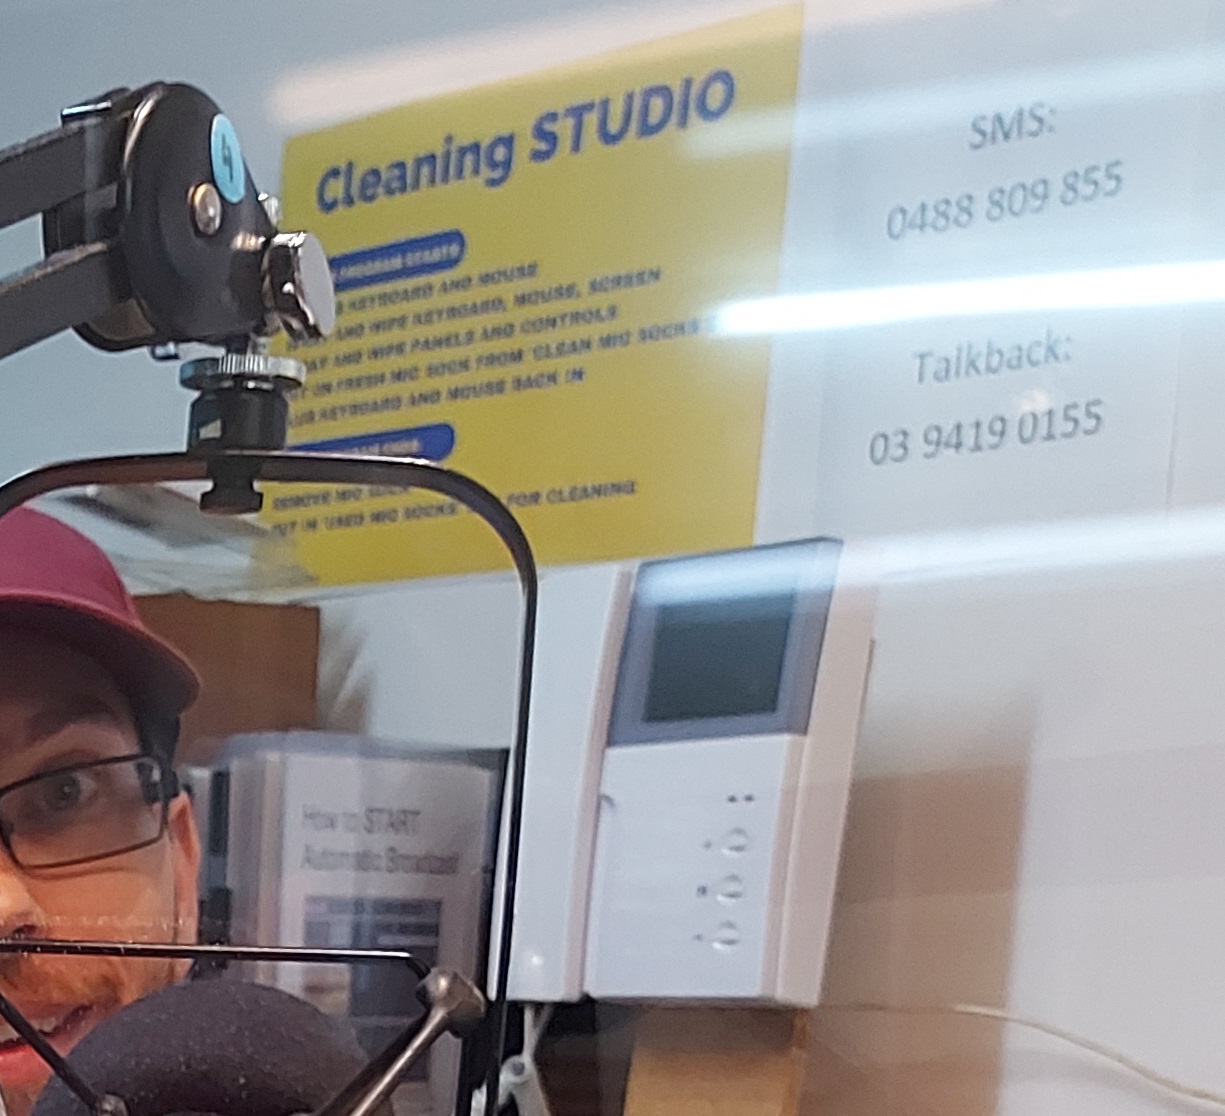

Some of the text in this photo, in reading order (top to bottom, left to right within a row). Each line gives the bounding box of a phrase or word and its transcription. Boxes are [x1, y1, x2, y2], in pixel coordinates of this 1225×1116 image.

[316, 68, 737, 214] Cleaning STUDIO
[968, 101, 1058, 150] SMS:
[886, 159, 1125, 241] 0488 809 855
[439, 275, 472, 293] AND
[478, 261, 538, 286] MOUSE
[588, 266, 662, 295] SCREEN
[481, 323, 516, 342] AND
[519, 303, 619, 335] CONTROLS
[598, 330, 631, 349] MIC
[912, 328, 1073, 385] Talkback:
[869, 397, 1105, 467] 03 9419 0155
[545, 480, 637, 505] CLEANING
